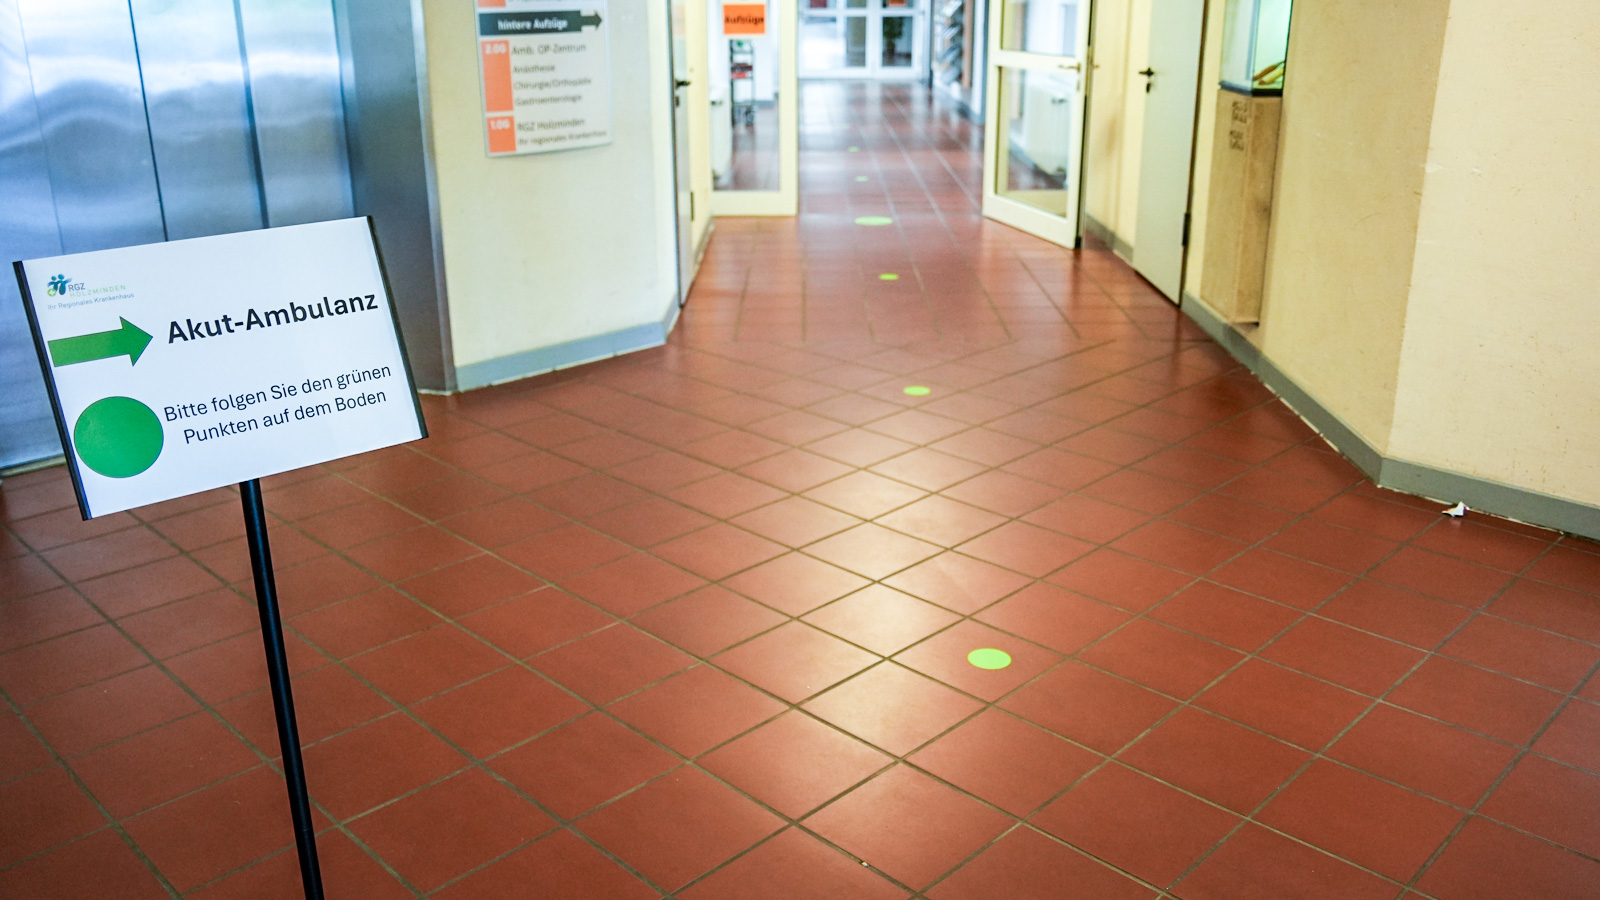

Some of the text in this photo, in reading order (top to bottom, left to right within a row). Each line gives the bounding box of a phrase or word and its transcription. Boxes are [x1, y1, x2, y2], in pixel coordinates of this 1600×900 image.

[498, 19, 531, 30] hintere
[517, 122, 534, 132] RGZ
[68, 283, 86, 292] RGZ
[69, 285, 126, 297] HOLZMINDEN
[58, 299, 92, 309] Regionales
[94, 293, 134, 303] Krankenhaus
[167, 293, 379, 345] Akut-Ambulanz
[164, 365, 392, 423] Bitte folgen Sie den grünen
[184, 390, 387, 445] Punkten auf dem Boden
